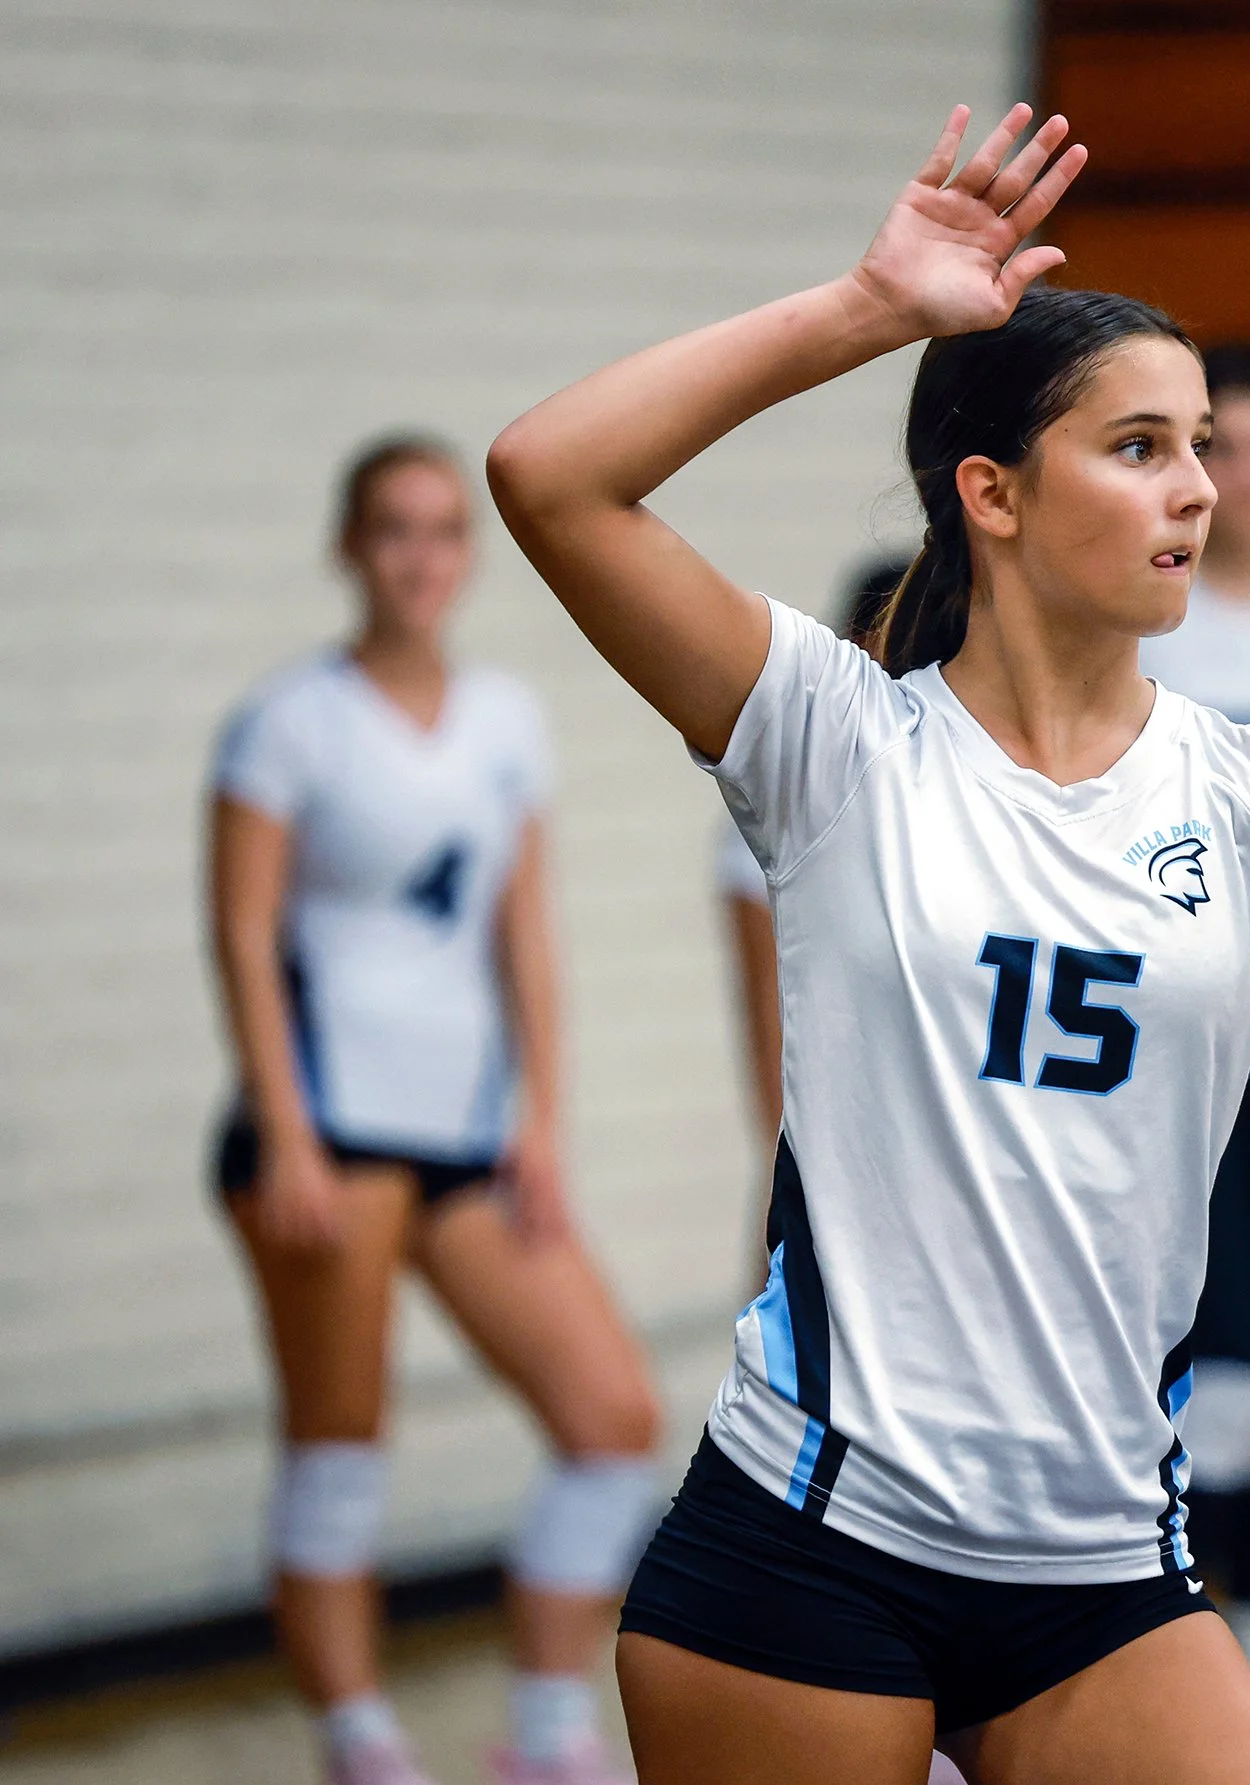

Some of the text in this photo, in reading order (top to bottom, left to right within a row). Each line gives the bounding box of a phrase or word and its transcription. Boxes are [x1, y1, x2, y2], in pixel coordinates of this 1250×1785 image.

[1122, 819, 1212, 866] VILLA PARK
[975, 931, 1146, 1097] 15
